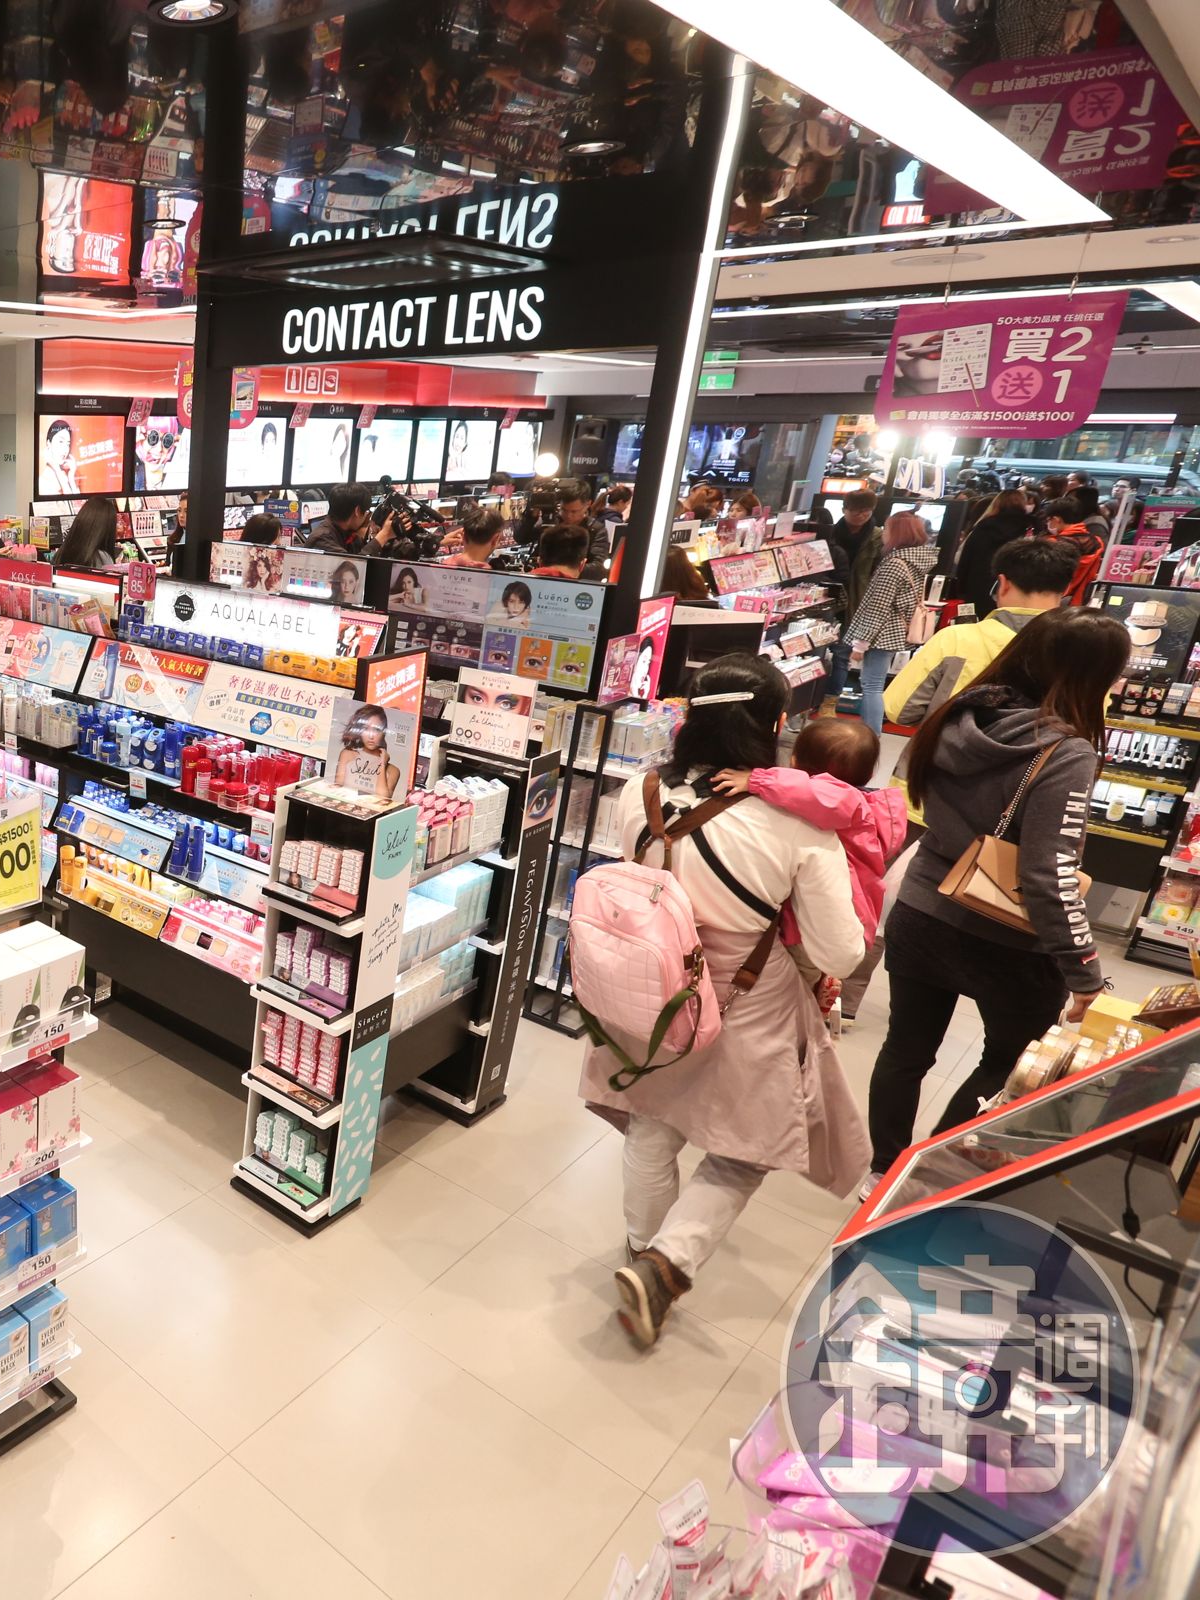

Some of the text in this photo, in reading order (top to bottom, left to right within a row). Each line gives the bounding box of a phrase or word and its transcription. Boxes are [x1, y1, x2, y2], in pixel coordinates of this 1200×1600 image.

[281, 286, 545, 355] CONTACT LENS
[1002, 326, 1093, 364] 買2
[997, 368, 1073, 405] 送 1
[684, 469, 751, 477] KATE
[11, 571, 36, 584] KOSÉ
[1109, 563, 1131, 576] 85
[130, 579, 143, 593] 85
[210, 602, 316, 636] AQUALABEL
[227, 675, 332, 707] 奢侈濕敷也不心疼
[351, 757, 381, 776] Select
[515, 858, 537, 951] PEGAVISION
[1176, 926, 1194, 934] 149
[357, 1008, 389, 1029] Sincere
[44, 1023, 64, 1038] 150
[34, 1150, 55, 1166] 200
[31, 1254, 51, 1272] 150
[40, 1320, 65, 1342] EVERYDAY
[41, 1335, 56, 1348] MASK
[0, 1346, 26, 1368] EVERYDAY
[0, 1361, 16, 1375] MASK
